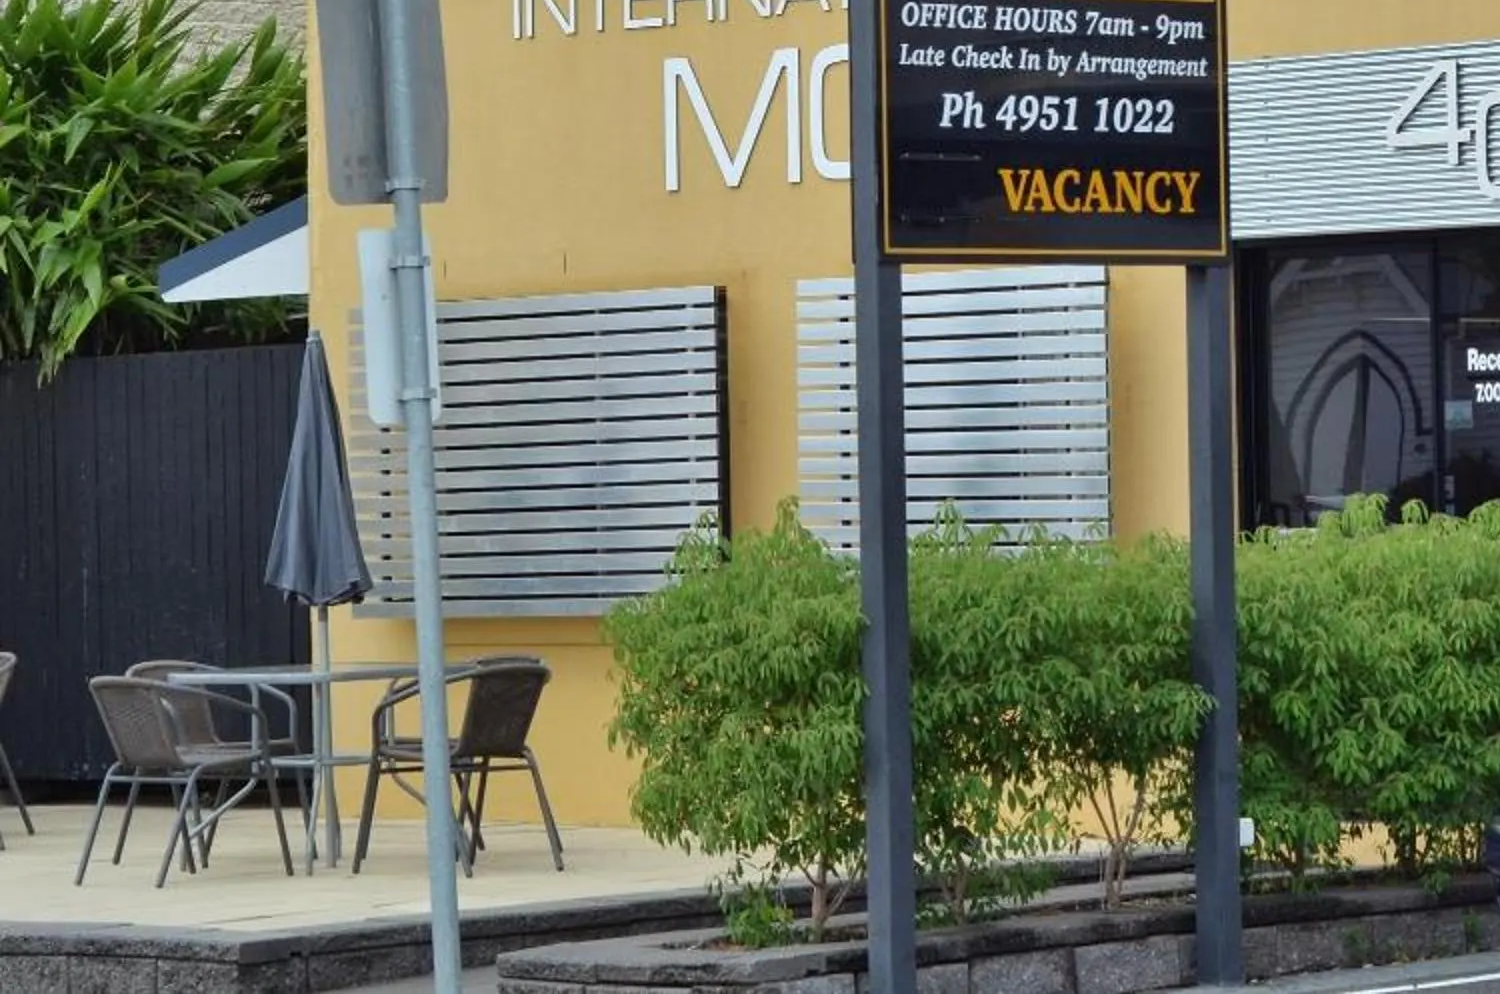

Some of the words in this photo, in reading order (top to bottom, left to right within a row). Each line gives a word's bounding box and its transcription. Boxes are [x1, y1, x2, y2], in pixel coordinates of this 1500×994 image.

[901, 1, 987, 30] OFFICE
[994, 5, 1077, 34] HOURS
[1085, 11, 1134, 37] 7am
[1155, 14, 1204, 45] 9pm
[900, 43, 945, 67] Late
[951, 44, 1013, 70] Check
[1018, 47, 1041, 71] In
[1047, 48, 1070, 77] by
[1076, 51, 1208, 82] Arrangement
[939, 90, 986, 130] Ph
[995, 95, 1079, 133] 4951
[1093, 98, 1175, 134] 1022
[998, 168, 1201, 215] VACANCY
